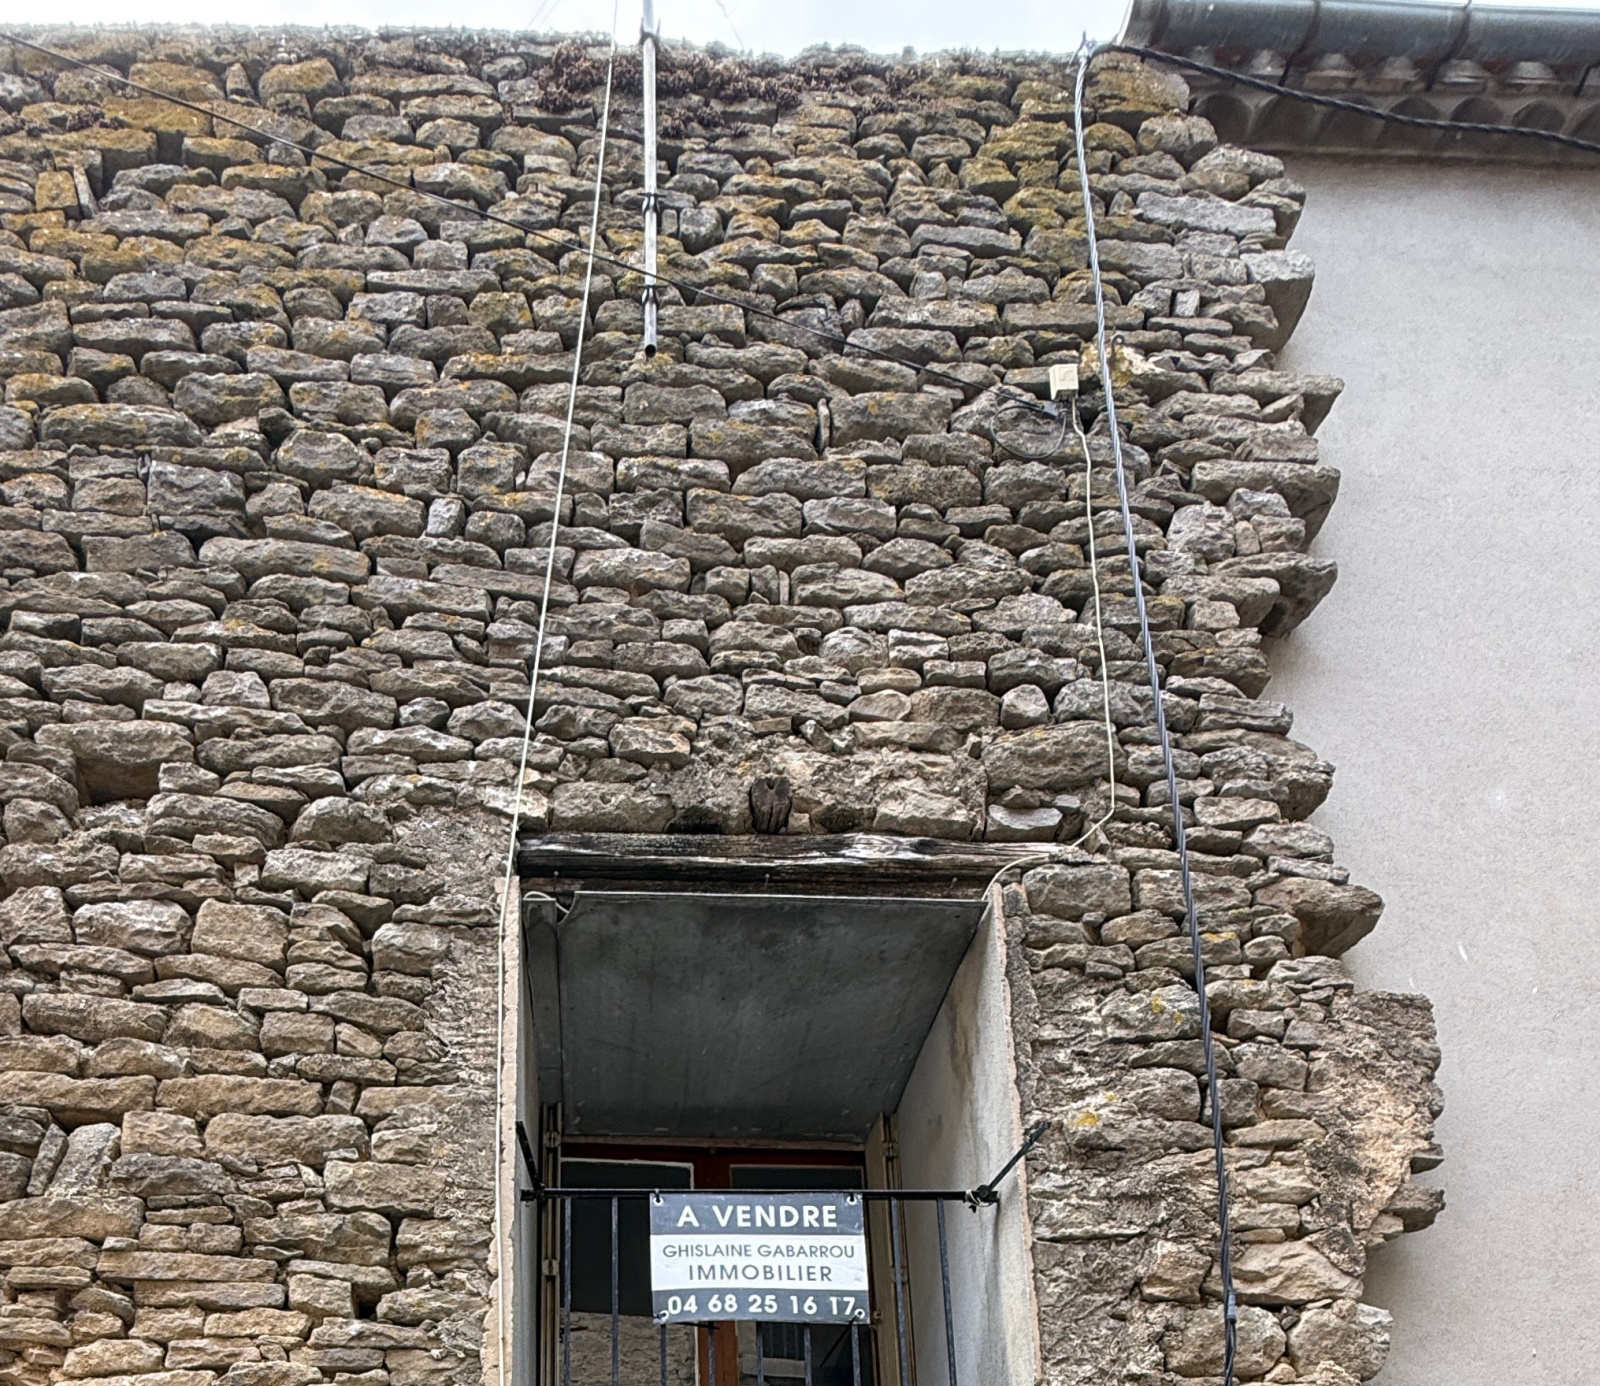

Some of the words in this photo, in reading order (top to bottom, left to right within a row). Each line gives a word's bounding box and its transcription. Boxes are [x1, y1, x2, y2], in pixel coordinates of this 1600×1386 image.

[676, 1205, 700, 1227] A
[712, 1205, 838, 1228] VENDRE
[662, 1244, 752, 1258] GHISLAINE
[757, 1244, 855, 1259] GABARROU
[688, 1264, 832, 1282] IMMOBILIER
[667, 1295, 698, 1315] 04
[708, 1294, 738, 1313] 68
[748, 1294, 778, 1314] 25
[790, 1295, 818, 1315] 16
[829, 1296, 856, 1316] 17
